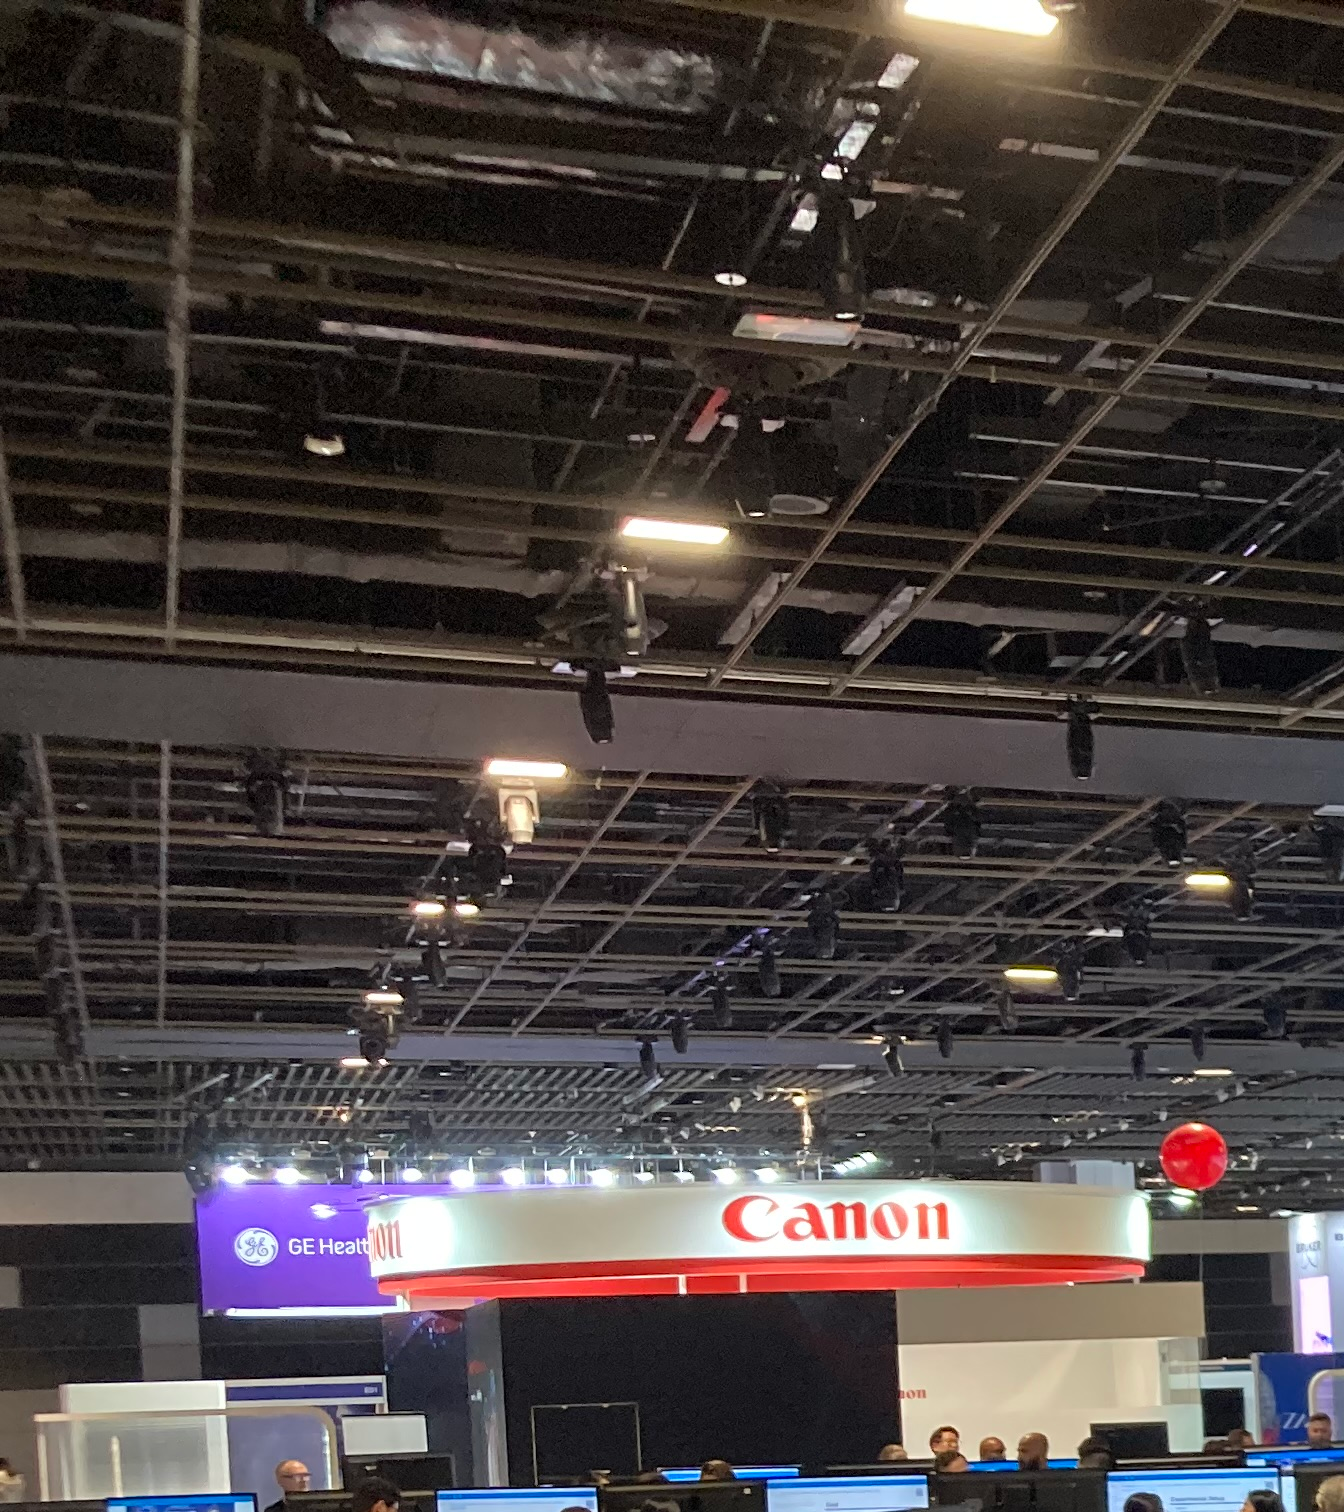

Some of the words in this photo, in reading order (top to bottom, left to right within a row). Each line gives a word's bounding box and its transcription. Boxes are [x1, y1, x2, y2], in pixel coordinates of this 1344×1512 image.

[722, 1195, 949, 1242] Canon
[288, 1238, 315, 1255] GE
[319, 1238, 370, 1255] Healt
[898, 1389, 927, 1399] non
